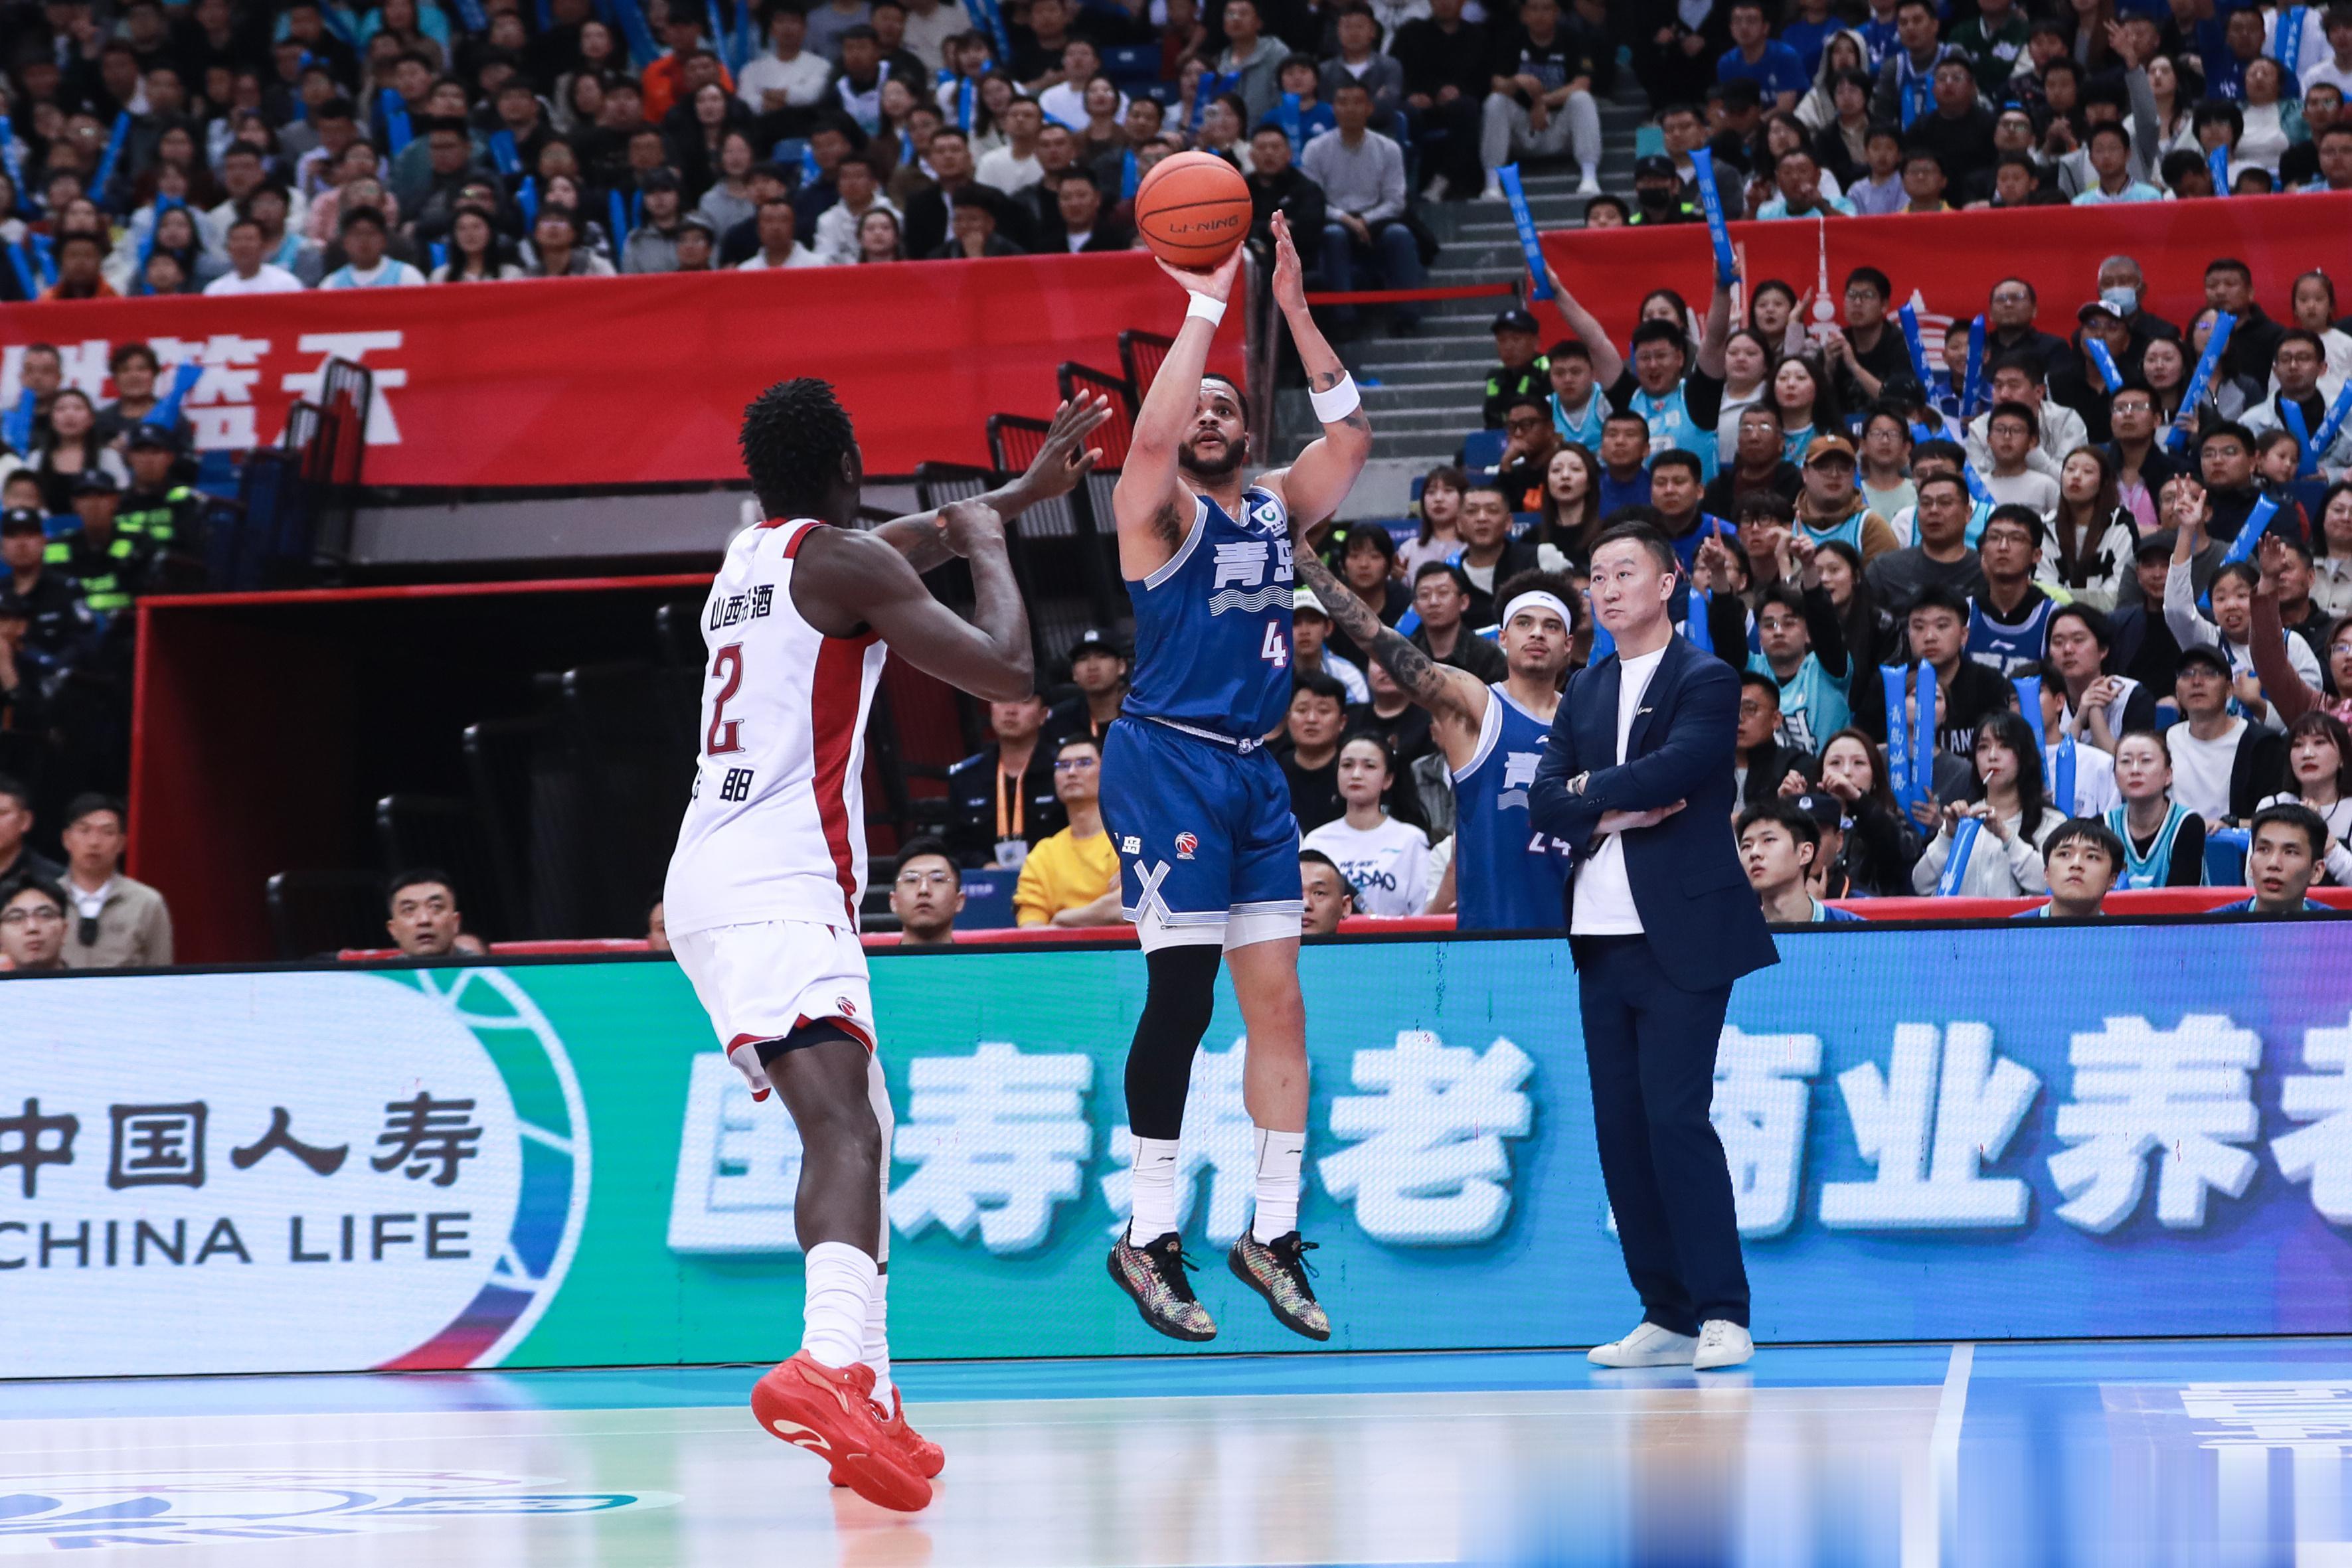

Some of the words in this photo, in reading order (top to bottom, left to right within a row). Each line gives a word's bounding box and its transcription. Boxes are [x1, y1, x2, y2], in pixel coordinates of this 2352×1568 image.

[1261, 620, 1288, 668] 4
[707, 641, 745, 757] 2
[0, 1091, 483, 1199] 中国人寿
[0, 1217, 253, 1270] CHINA
[290, 1212, 471, 1263] LIFE
